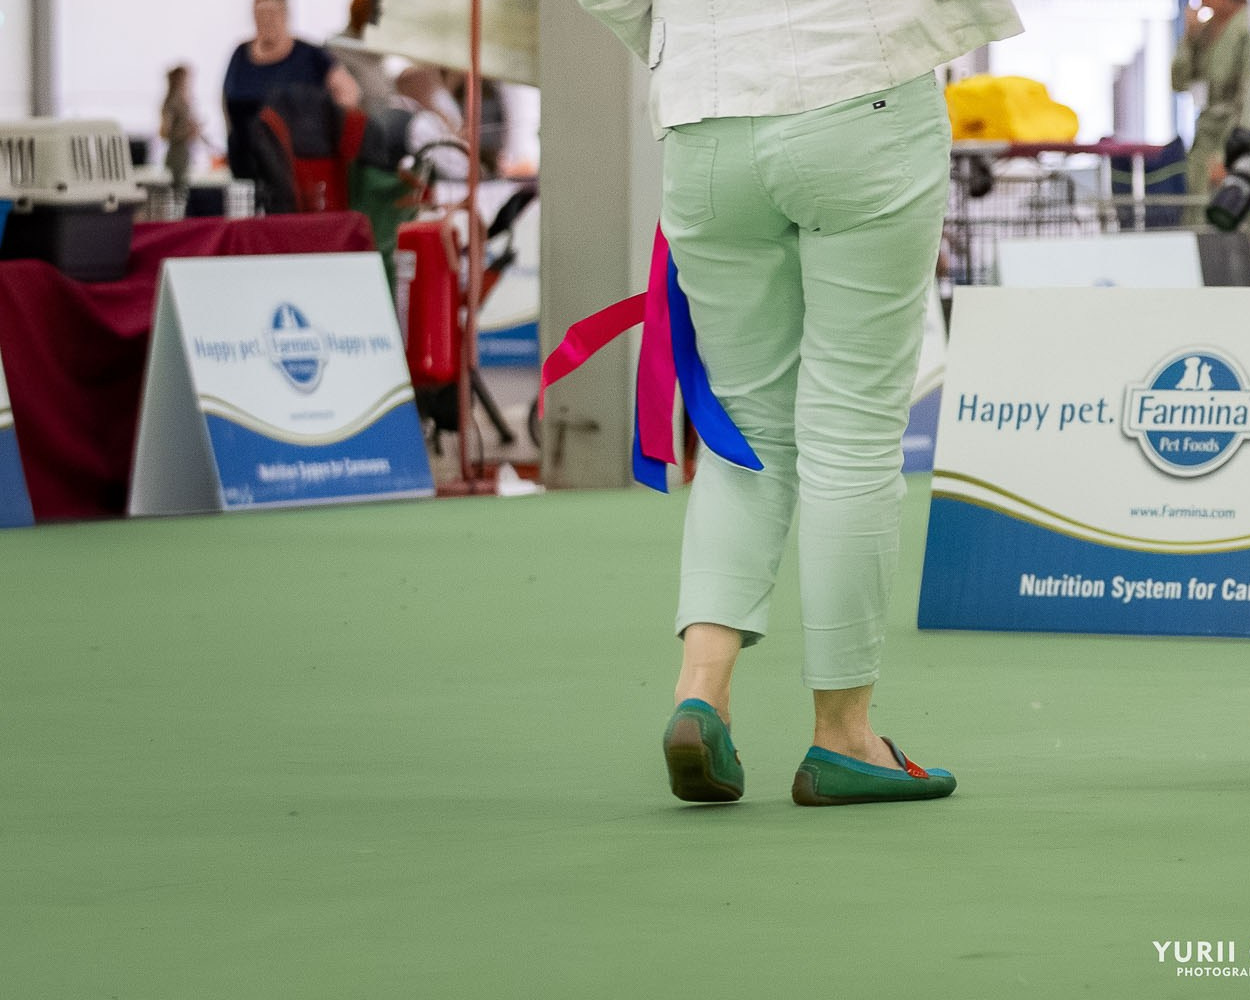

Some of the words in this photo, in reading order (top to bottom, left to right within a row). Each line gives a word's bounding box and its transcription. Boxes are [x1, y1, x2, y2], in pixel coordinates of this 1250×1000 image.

[958, 394, 1050, 431] Happy
[1059, 397, 1115, 431] pet.
[1138, 395, 1249, 426] Farmina
[1159, 436, 1181, 452] Pet
[1182, 436, 1220, 452] Foods
[1019, 574, 1105, 598] Nutrition
[1110, 576, 1182, 604] System
[1187, 578, 1216, 600] for
